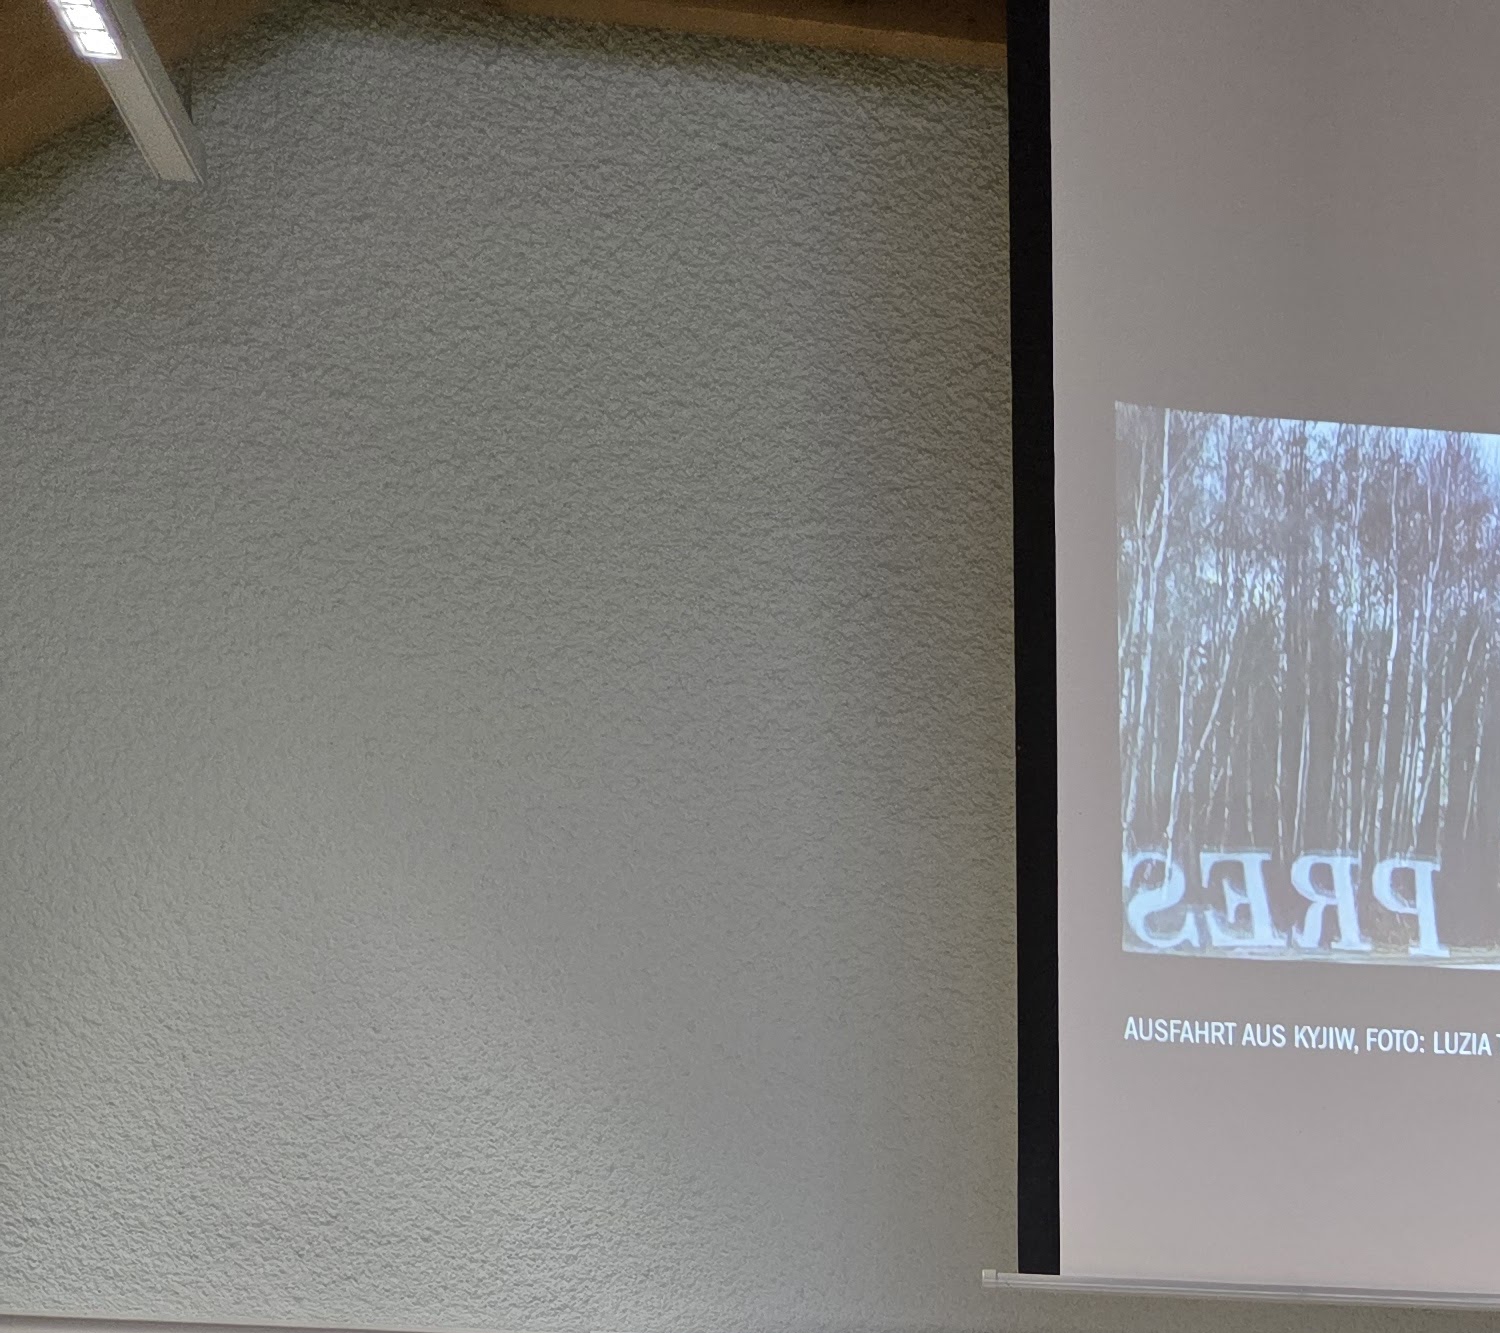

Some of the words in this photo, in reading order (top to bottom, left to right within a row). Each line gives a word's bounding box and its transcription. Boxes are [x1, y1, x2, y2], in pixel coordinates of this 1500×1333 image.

[1123, 1016, 1236, 1047] AUSFAHRT
[1241, 1022, 1286, 1049] AUS
[1293, 1025, 1359, 1054] KYJIW,
[1366, 1028, 1425, 1053] FOTO:
[1433, 1030, 1492, 1057] LUZIA
